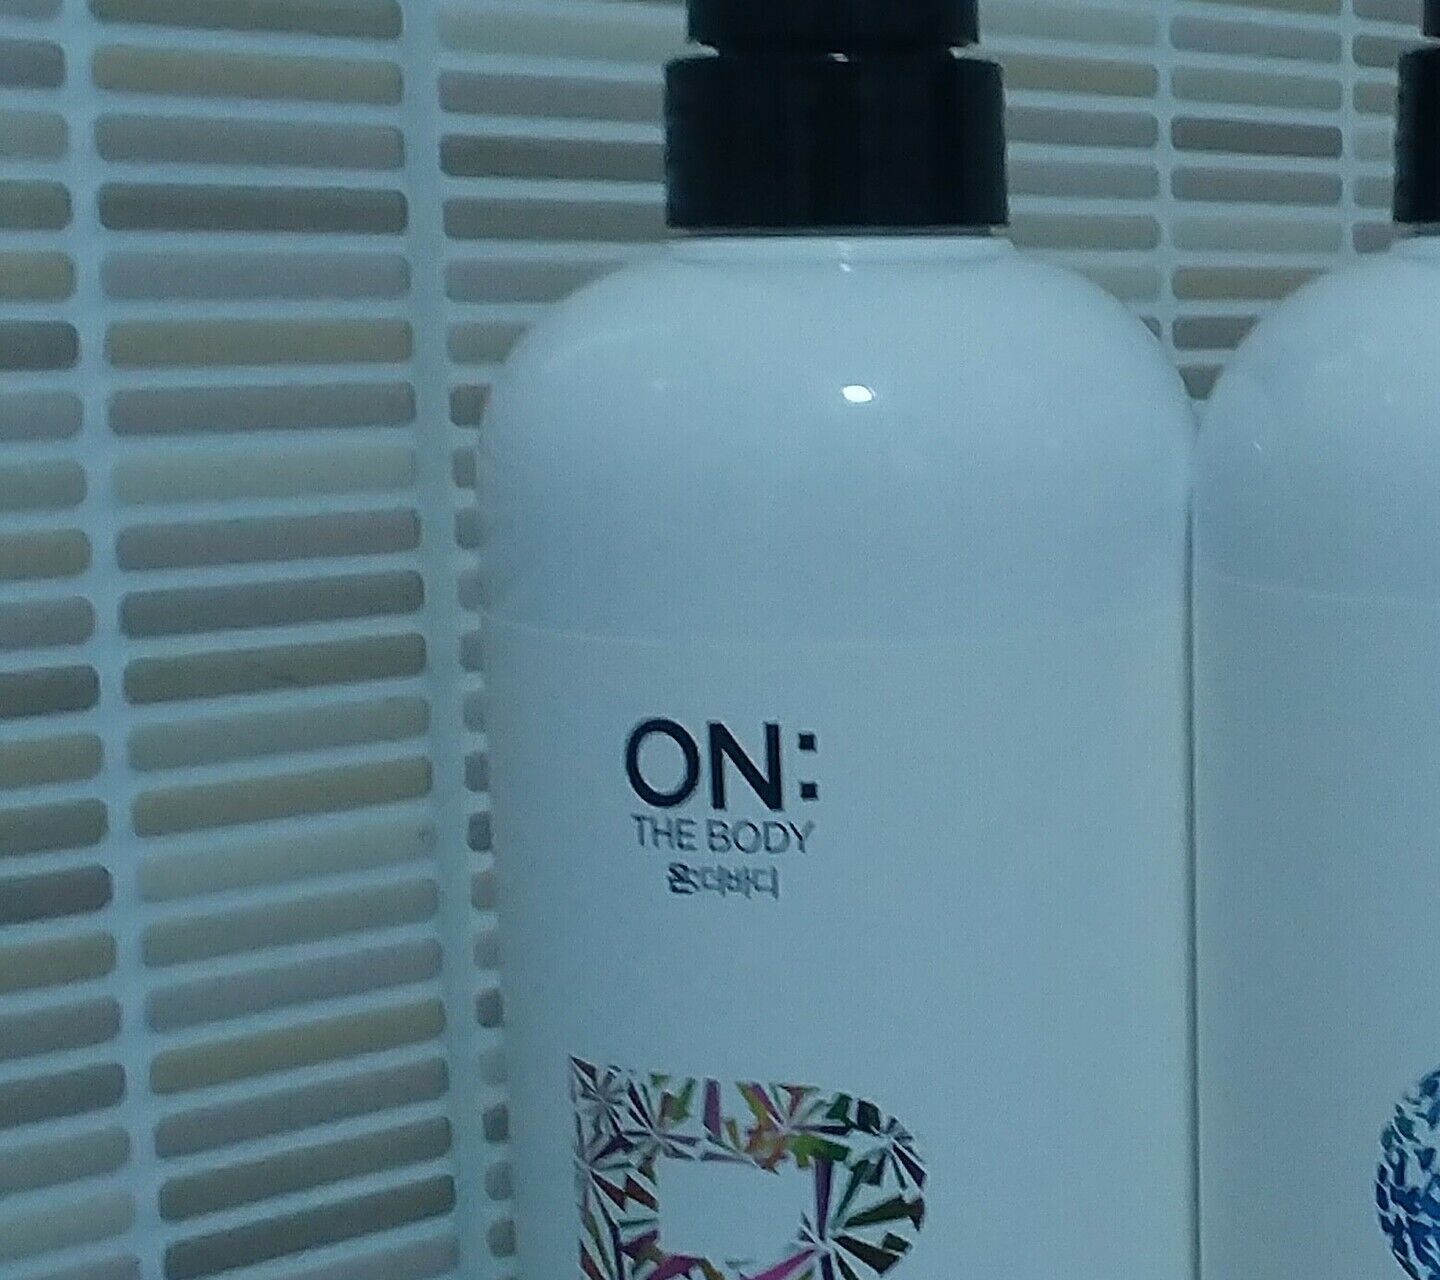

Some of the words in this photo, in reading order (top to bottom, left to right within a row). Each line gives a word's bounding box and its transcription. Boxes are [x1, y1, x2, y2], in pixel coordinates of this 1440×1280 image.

[626, 719, 817, 810] ON:
[631, 813, 697, 851] THE
[706, 818, 815, 853] BODY
